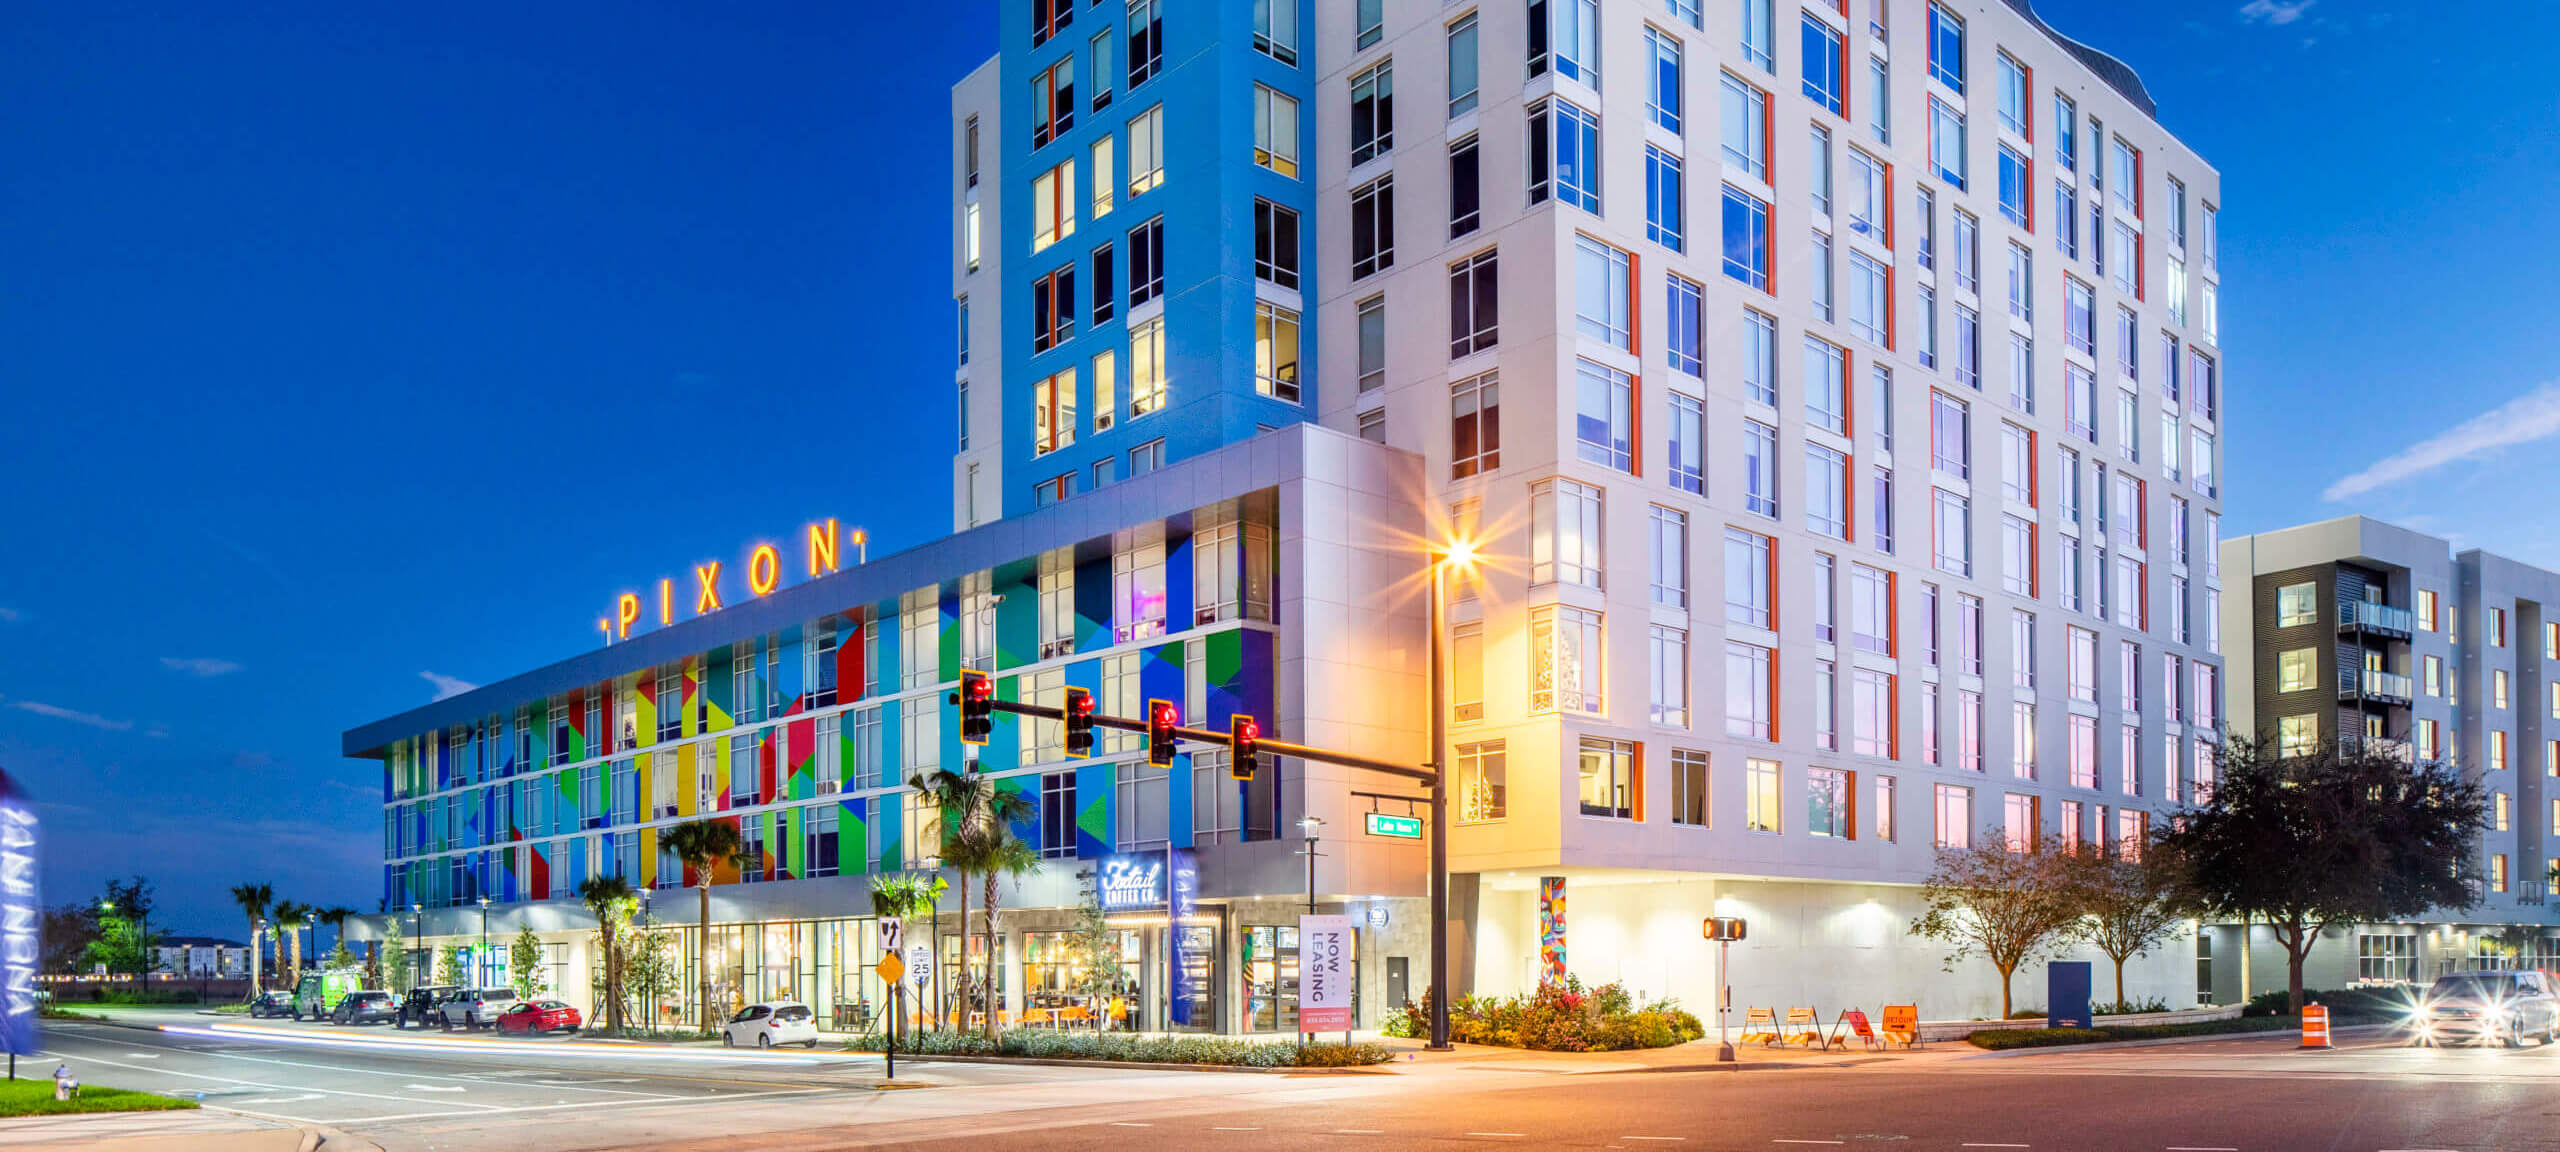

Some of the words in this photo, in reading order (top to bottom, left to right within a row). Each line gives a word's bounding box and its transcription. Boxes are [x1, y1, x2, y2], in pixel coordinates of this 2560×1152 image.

[618, 518, 842, 639] PIXON
[1103, 861, 1161, 890] Foxtail
[913, 964, 929, 973] 25
[1312, 932, 1324, 1002] LEASING
[1328, 932, 1339, 972] NOW
